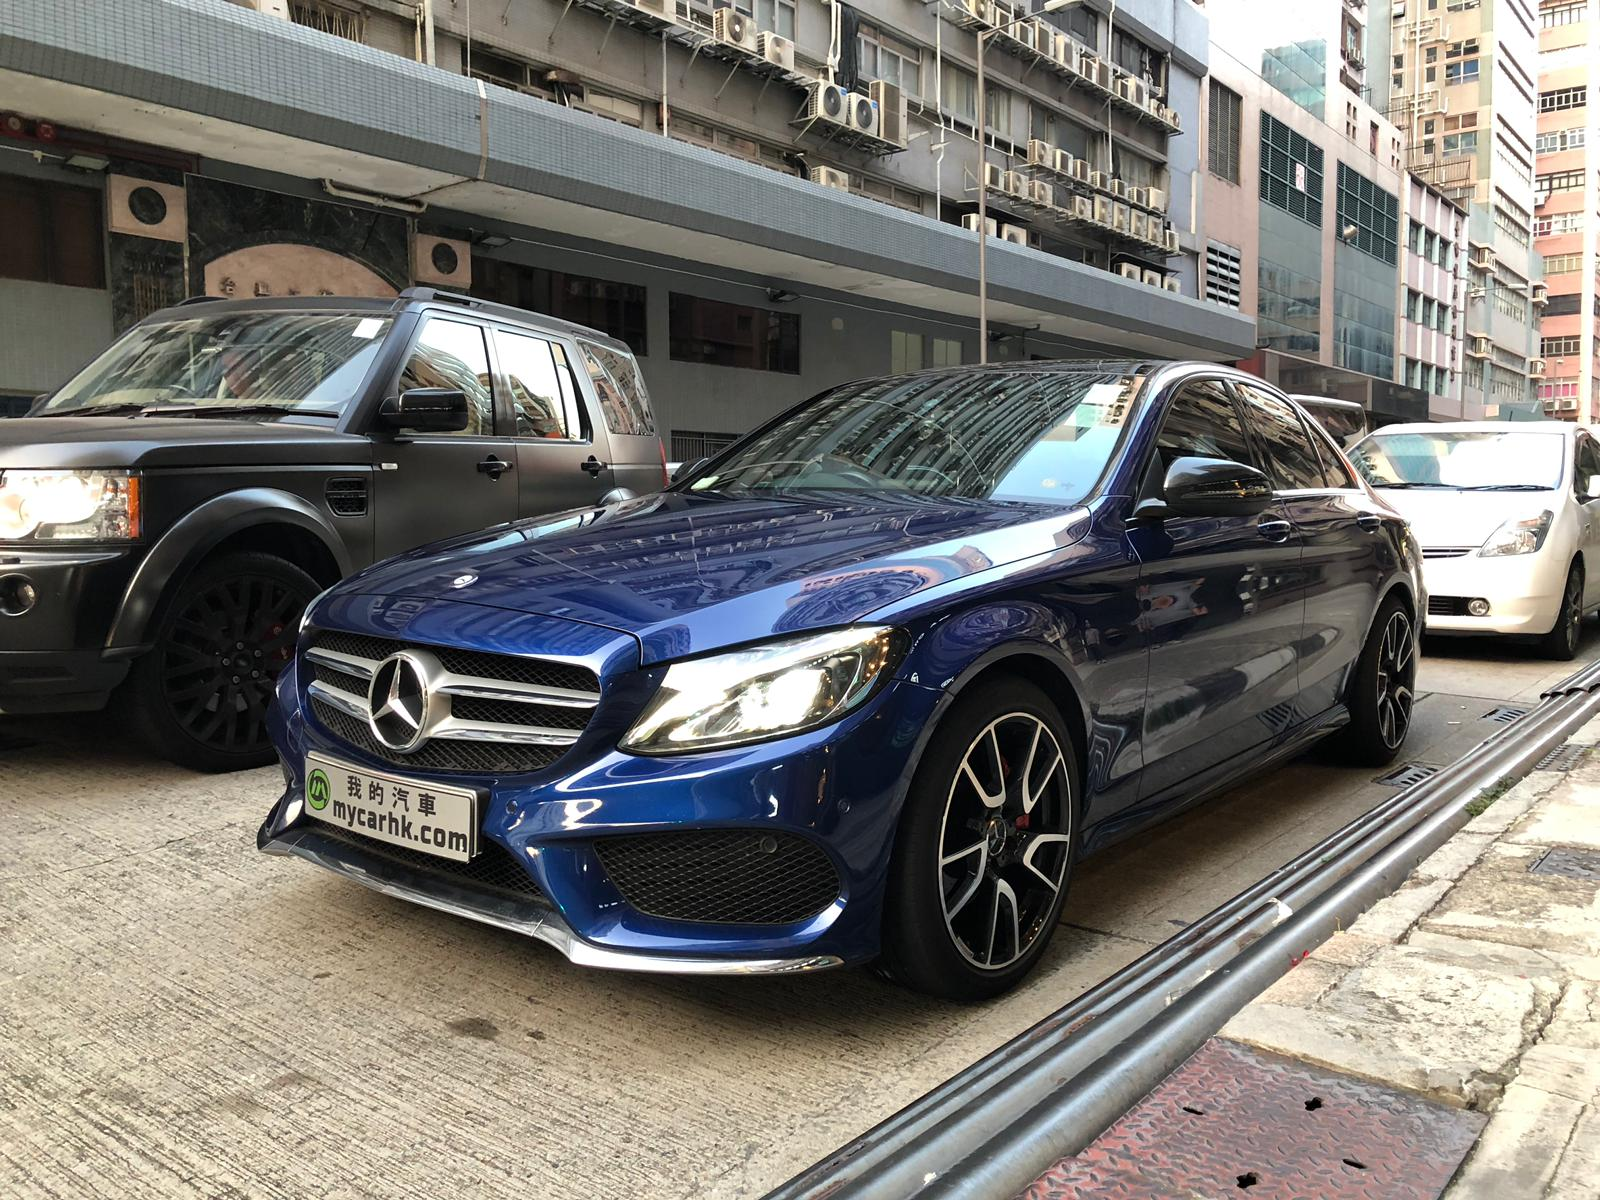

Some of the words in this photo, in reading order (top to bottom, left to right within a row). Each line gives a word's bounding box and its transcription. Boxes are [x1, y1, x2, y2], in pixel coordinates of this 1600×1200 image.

[347, 775, 436, 817] 我的汽車
[333, 799, 468, 853] mycarhk.com
